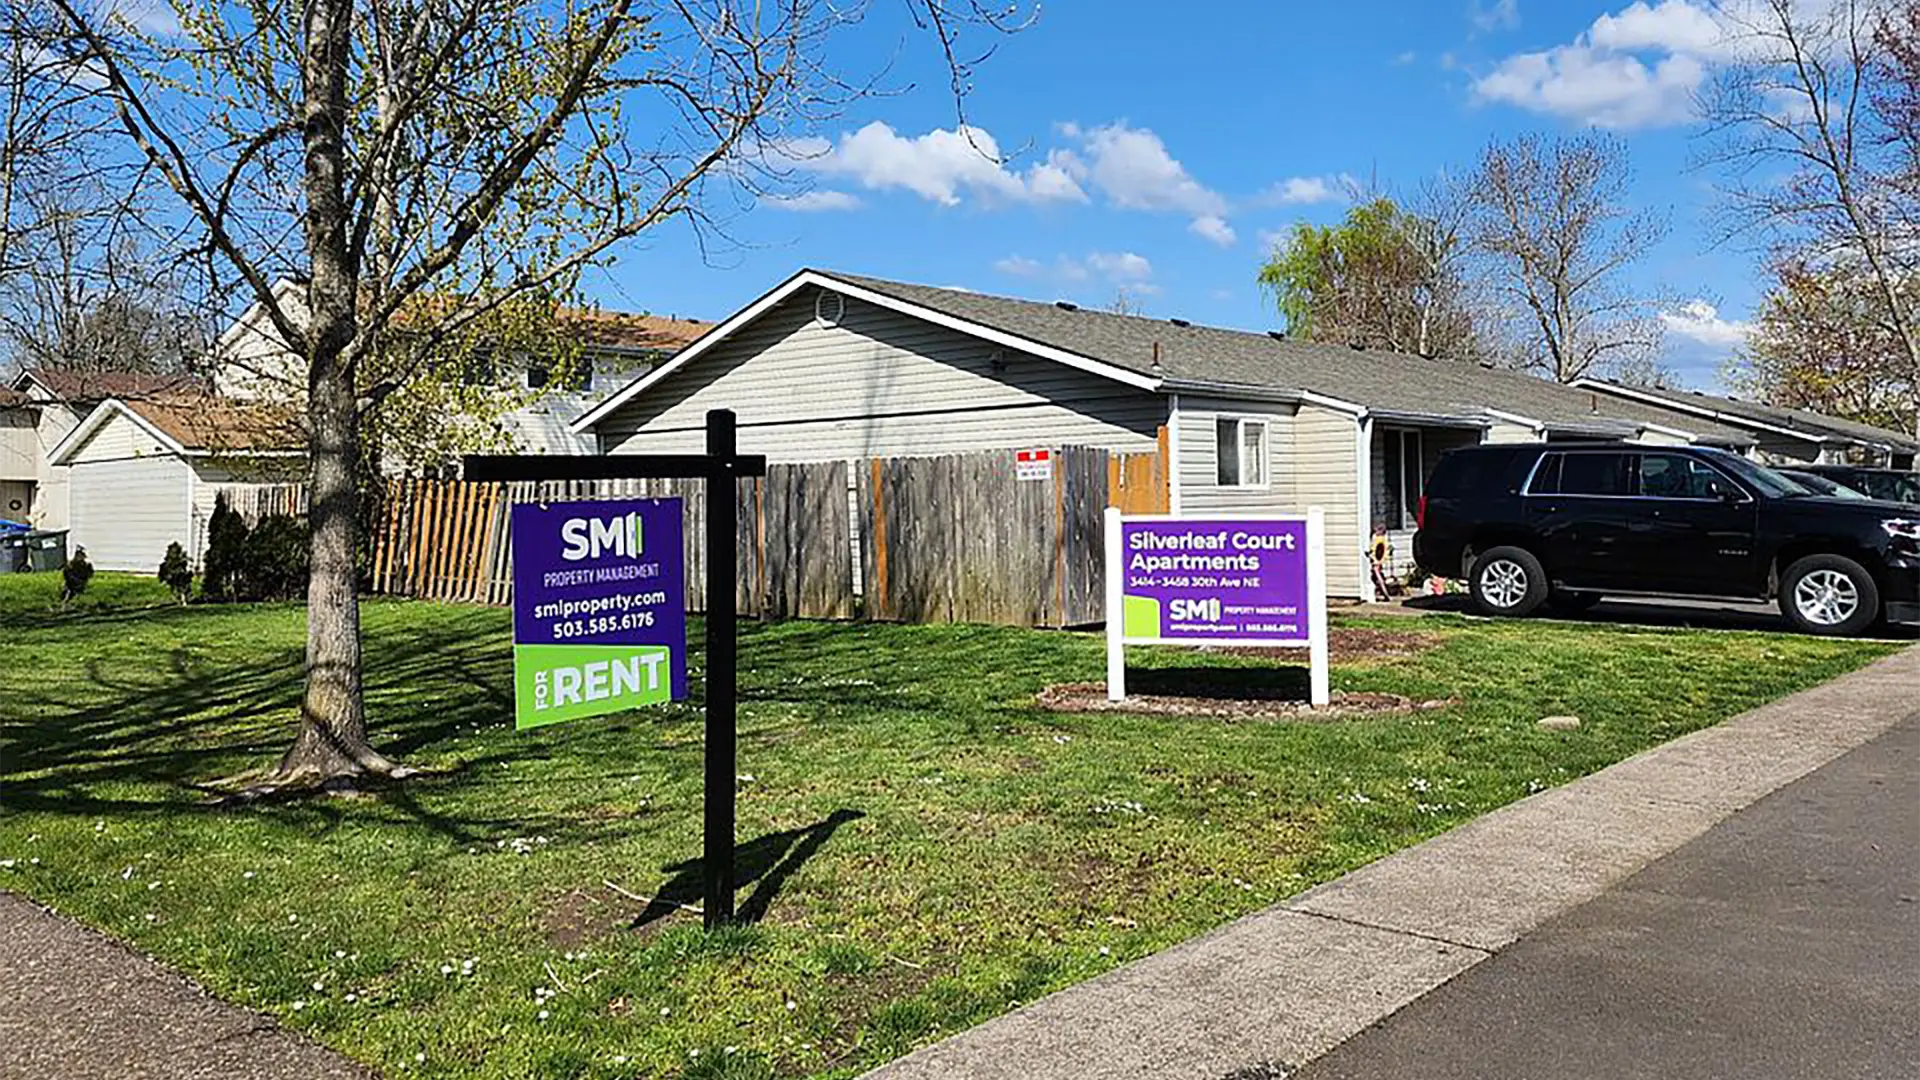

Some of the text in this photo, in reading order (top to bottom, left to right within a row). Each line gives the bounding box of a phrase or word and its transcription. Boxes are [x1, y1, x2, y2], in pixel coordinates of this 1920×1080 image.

[1129, 531, 1296, 550] Silverleaf Court
[544, 563, 660, 588] PROPERTY MANAGEMENT
[1129, 553, 1260, 573] Apartments
[1191, 576, 1218, 588] 30th
[1219, 576, 1241, 588] Ave
[553, 611, 655, 639] 503.585.6176
[535, 670, 549, 711] FOR
[552, 651, 665, 708] RENT
